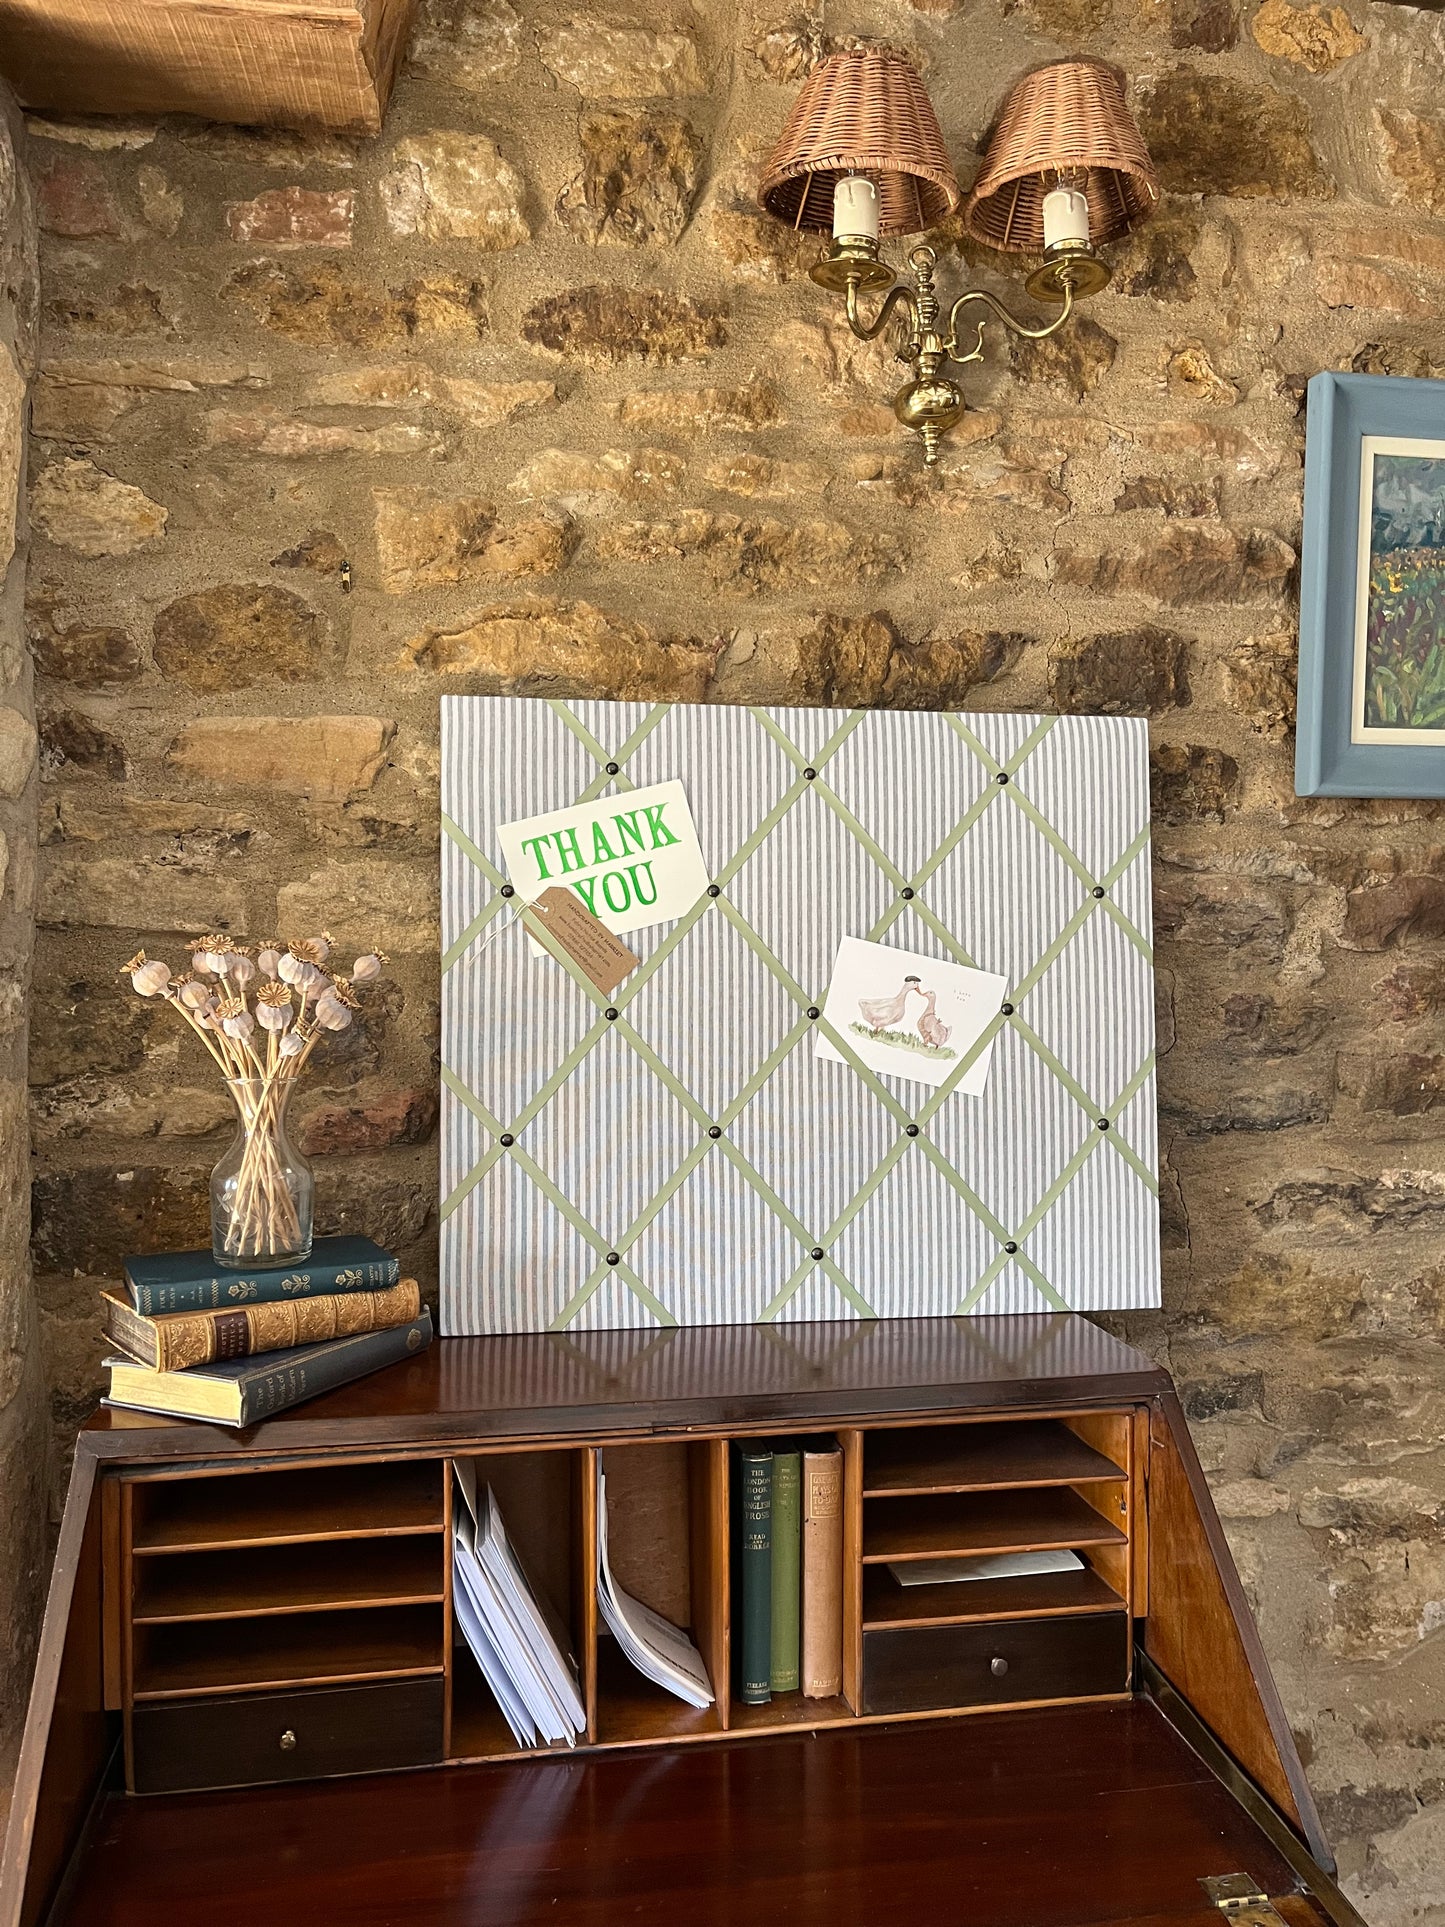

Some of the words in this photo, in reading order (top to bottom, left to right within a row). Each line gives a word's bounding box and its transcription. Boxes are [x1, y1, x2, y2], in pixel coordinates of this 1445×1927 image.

[521, 802, 681, 881] THANK
[571, 860, 657, 919] YOU
[744, 1477, 770, 1485] LONDON
[744, 1500, 770, 1510] ENGLISH
[745, 1511, 769, 1520] PROSE
